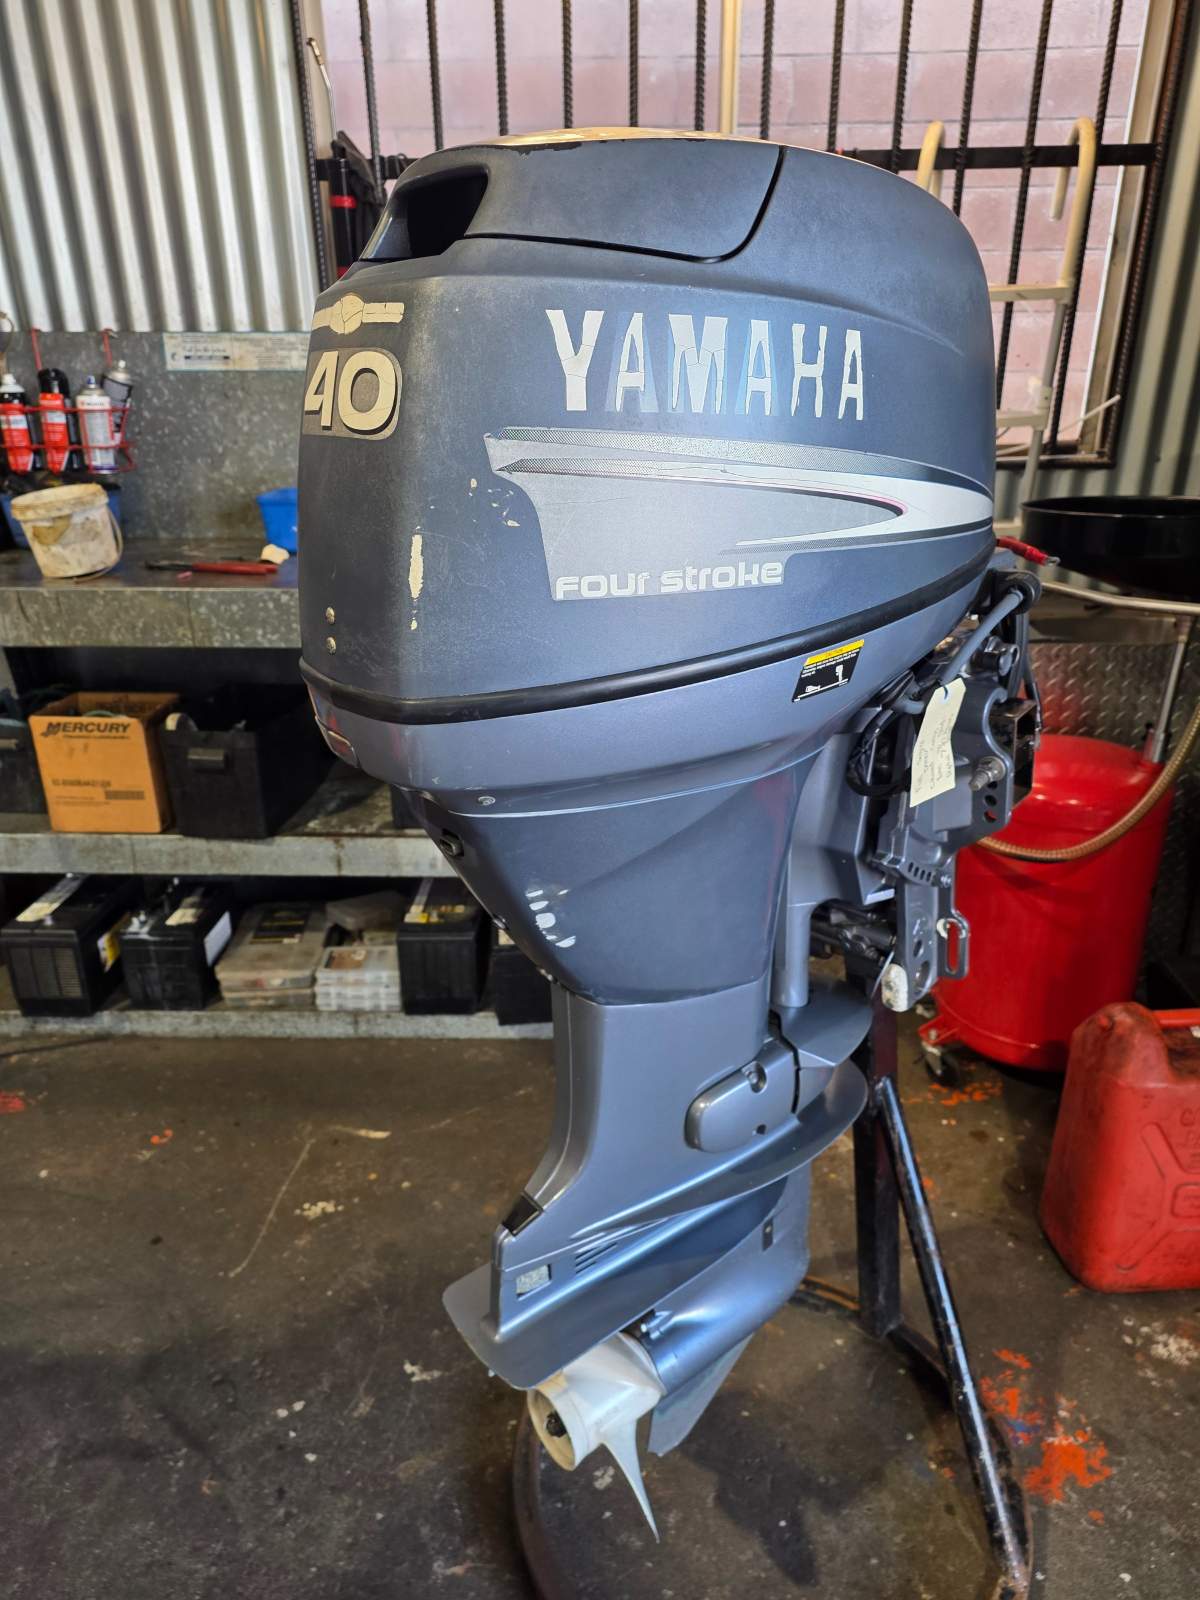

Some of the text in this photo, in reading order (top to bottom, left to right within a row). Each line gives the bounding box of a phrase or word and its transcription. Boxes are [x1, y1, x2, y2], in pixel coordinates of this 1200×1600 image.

[304, 350, 398, 435] 40
[545, 309, 863, 420] YAMAHA
[46, 722, 130, 735] MERCURY
